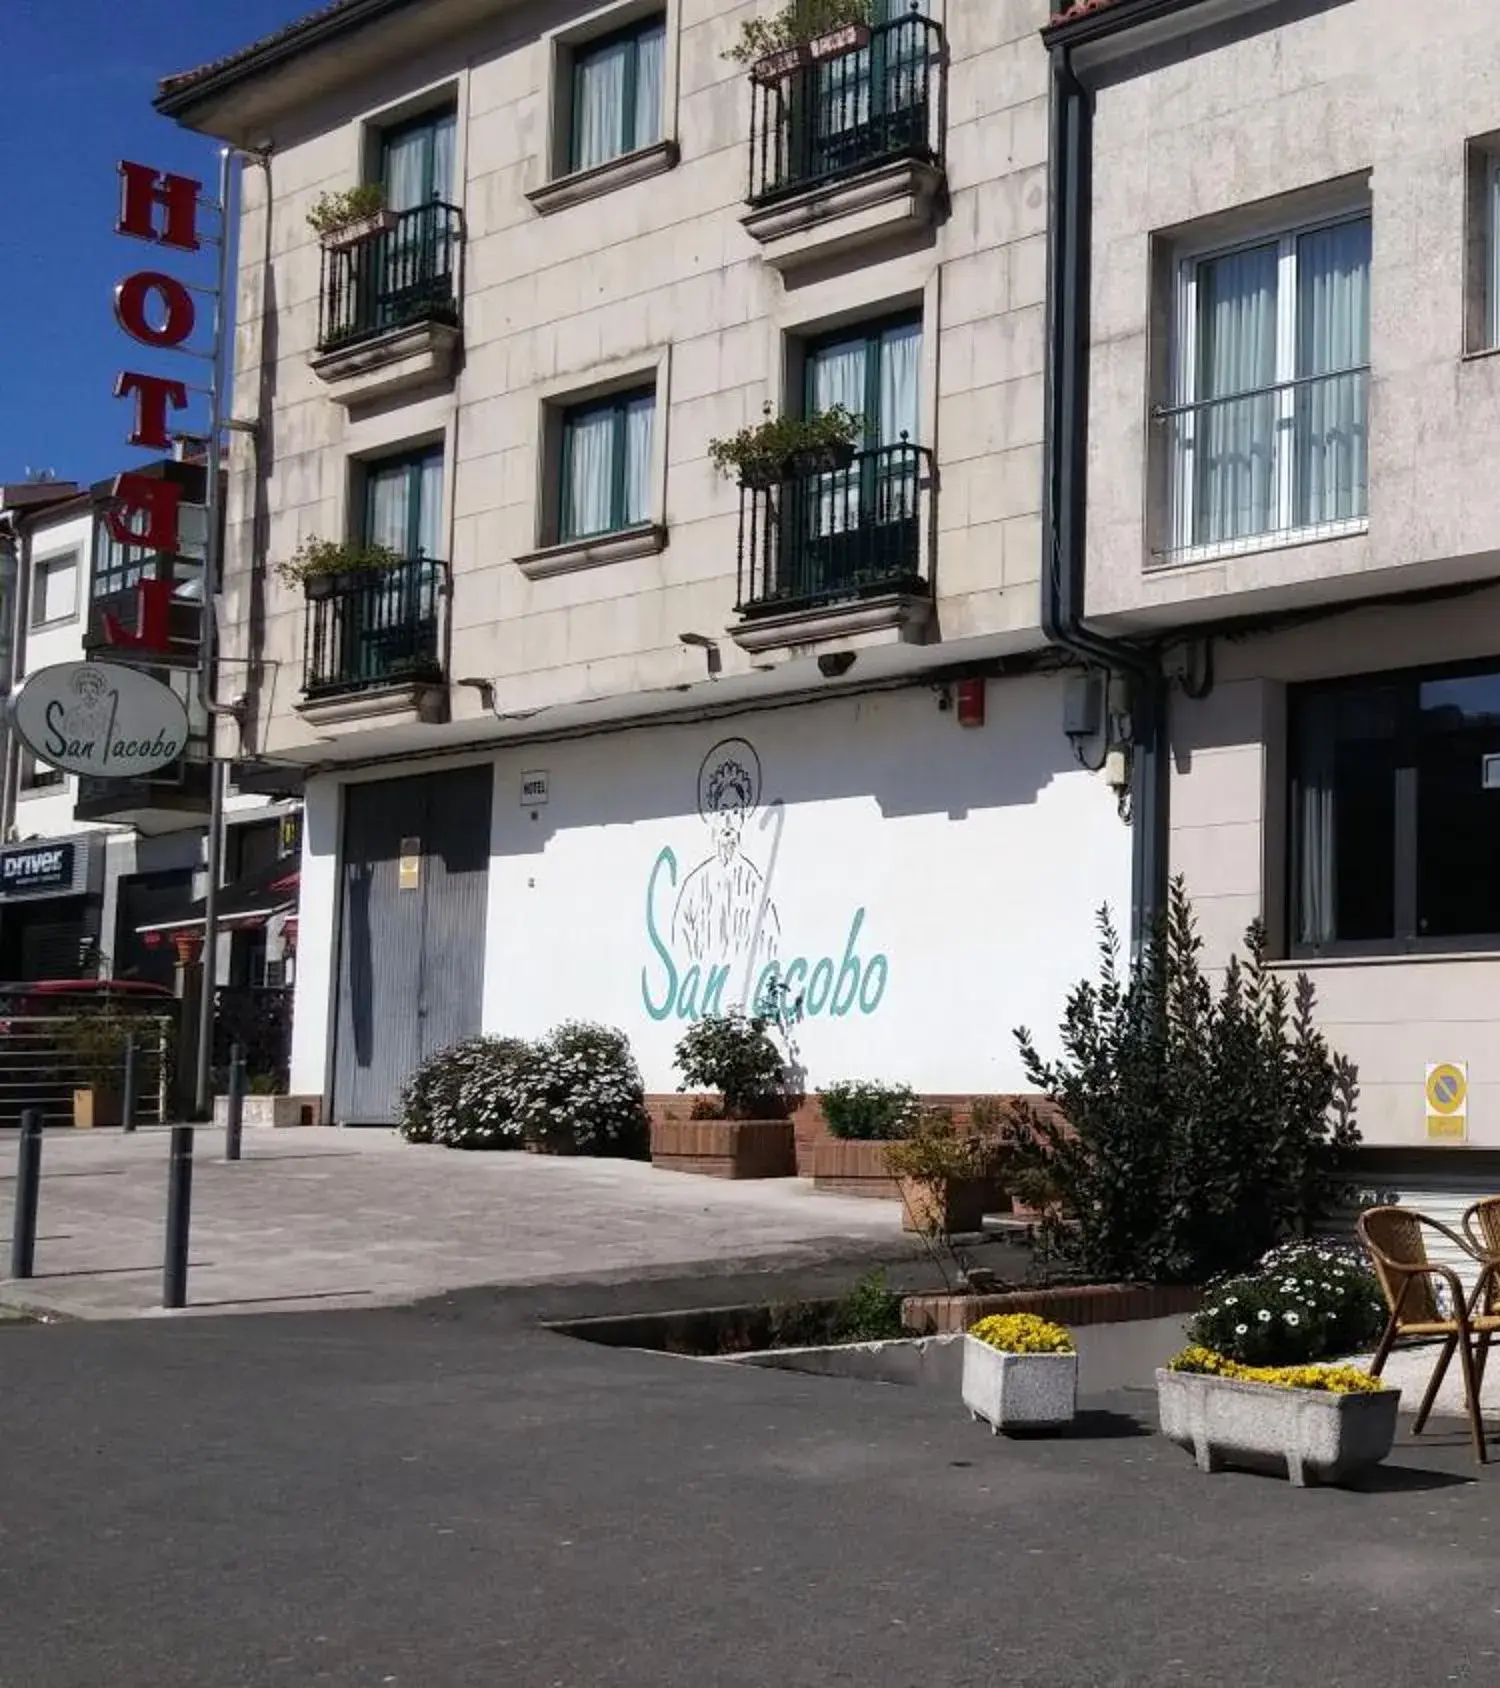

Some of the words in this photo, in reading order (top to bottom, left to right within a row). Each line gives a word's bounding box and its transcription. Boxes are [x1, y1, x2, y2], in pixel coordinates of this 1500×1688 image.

[45, 700, 96, 758] San
[523, 780, 546, 796] HOTEL
[641, 845, 731, 1020] San
